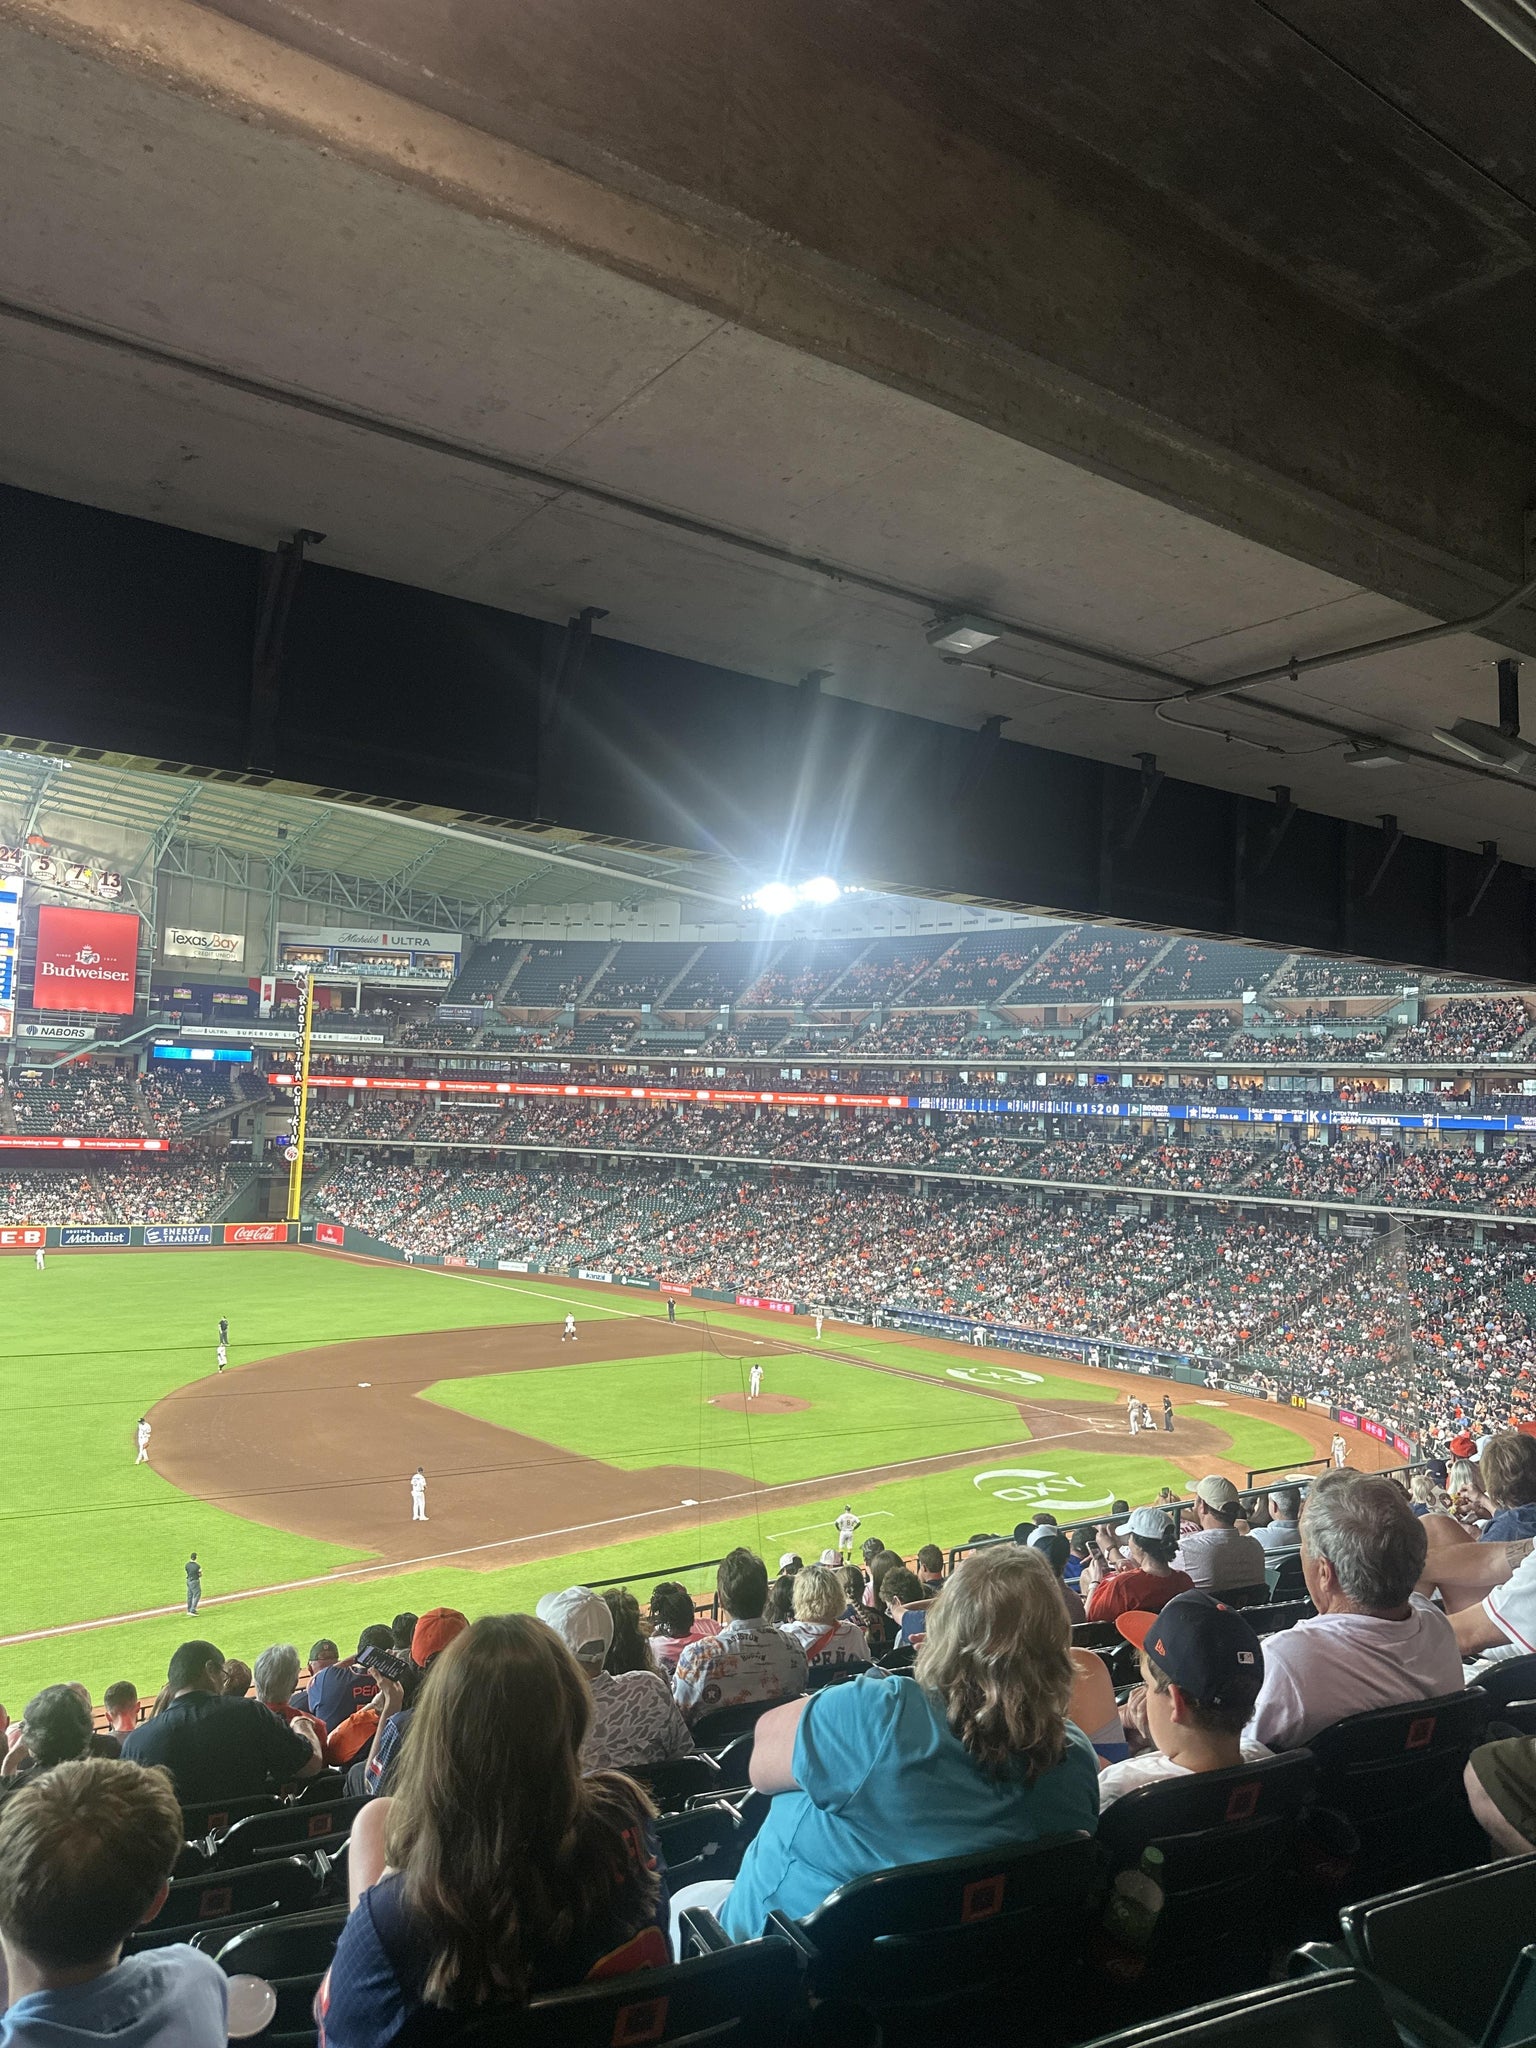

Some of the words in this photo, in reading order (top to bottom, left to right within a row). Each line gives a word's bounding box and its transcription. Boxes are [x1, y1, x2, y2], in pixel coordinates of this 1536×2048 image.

[38, 856, 50, 871] 5
[73, 865, 85, 879] 7
[101, 871, 120, 887] 13
[170, 930, 208, 946] Texas
[212, 934, 239, 953] Bay
[391, 936, 431, 947] ULTRA
[40, 1027, 86, 1037] NABORS
[1310, 1111, 1319, 1123] K
[1362, 1117, 1401, 1126] FASTBALL
[163, 1227, 201, 1236] ENERGY
[65, 1232, 125, 1244] Methodist
[162, 1234, 210, 1243] TRANSFER
[992, 1475, 1087, 1502] OXY
